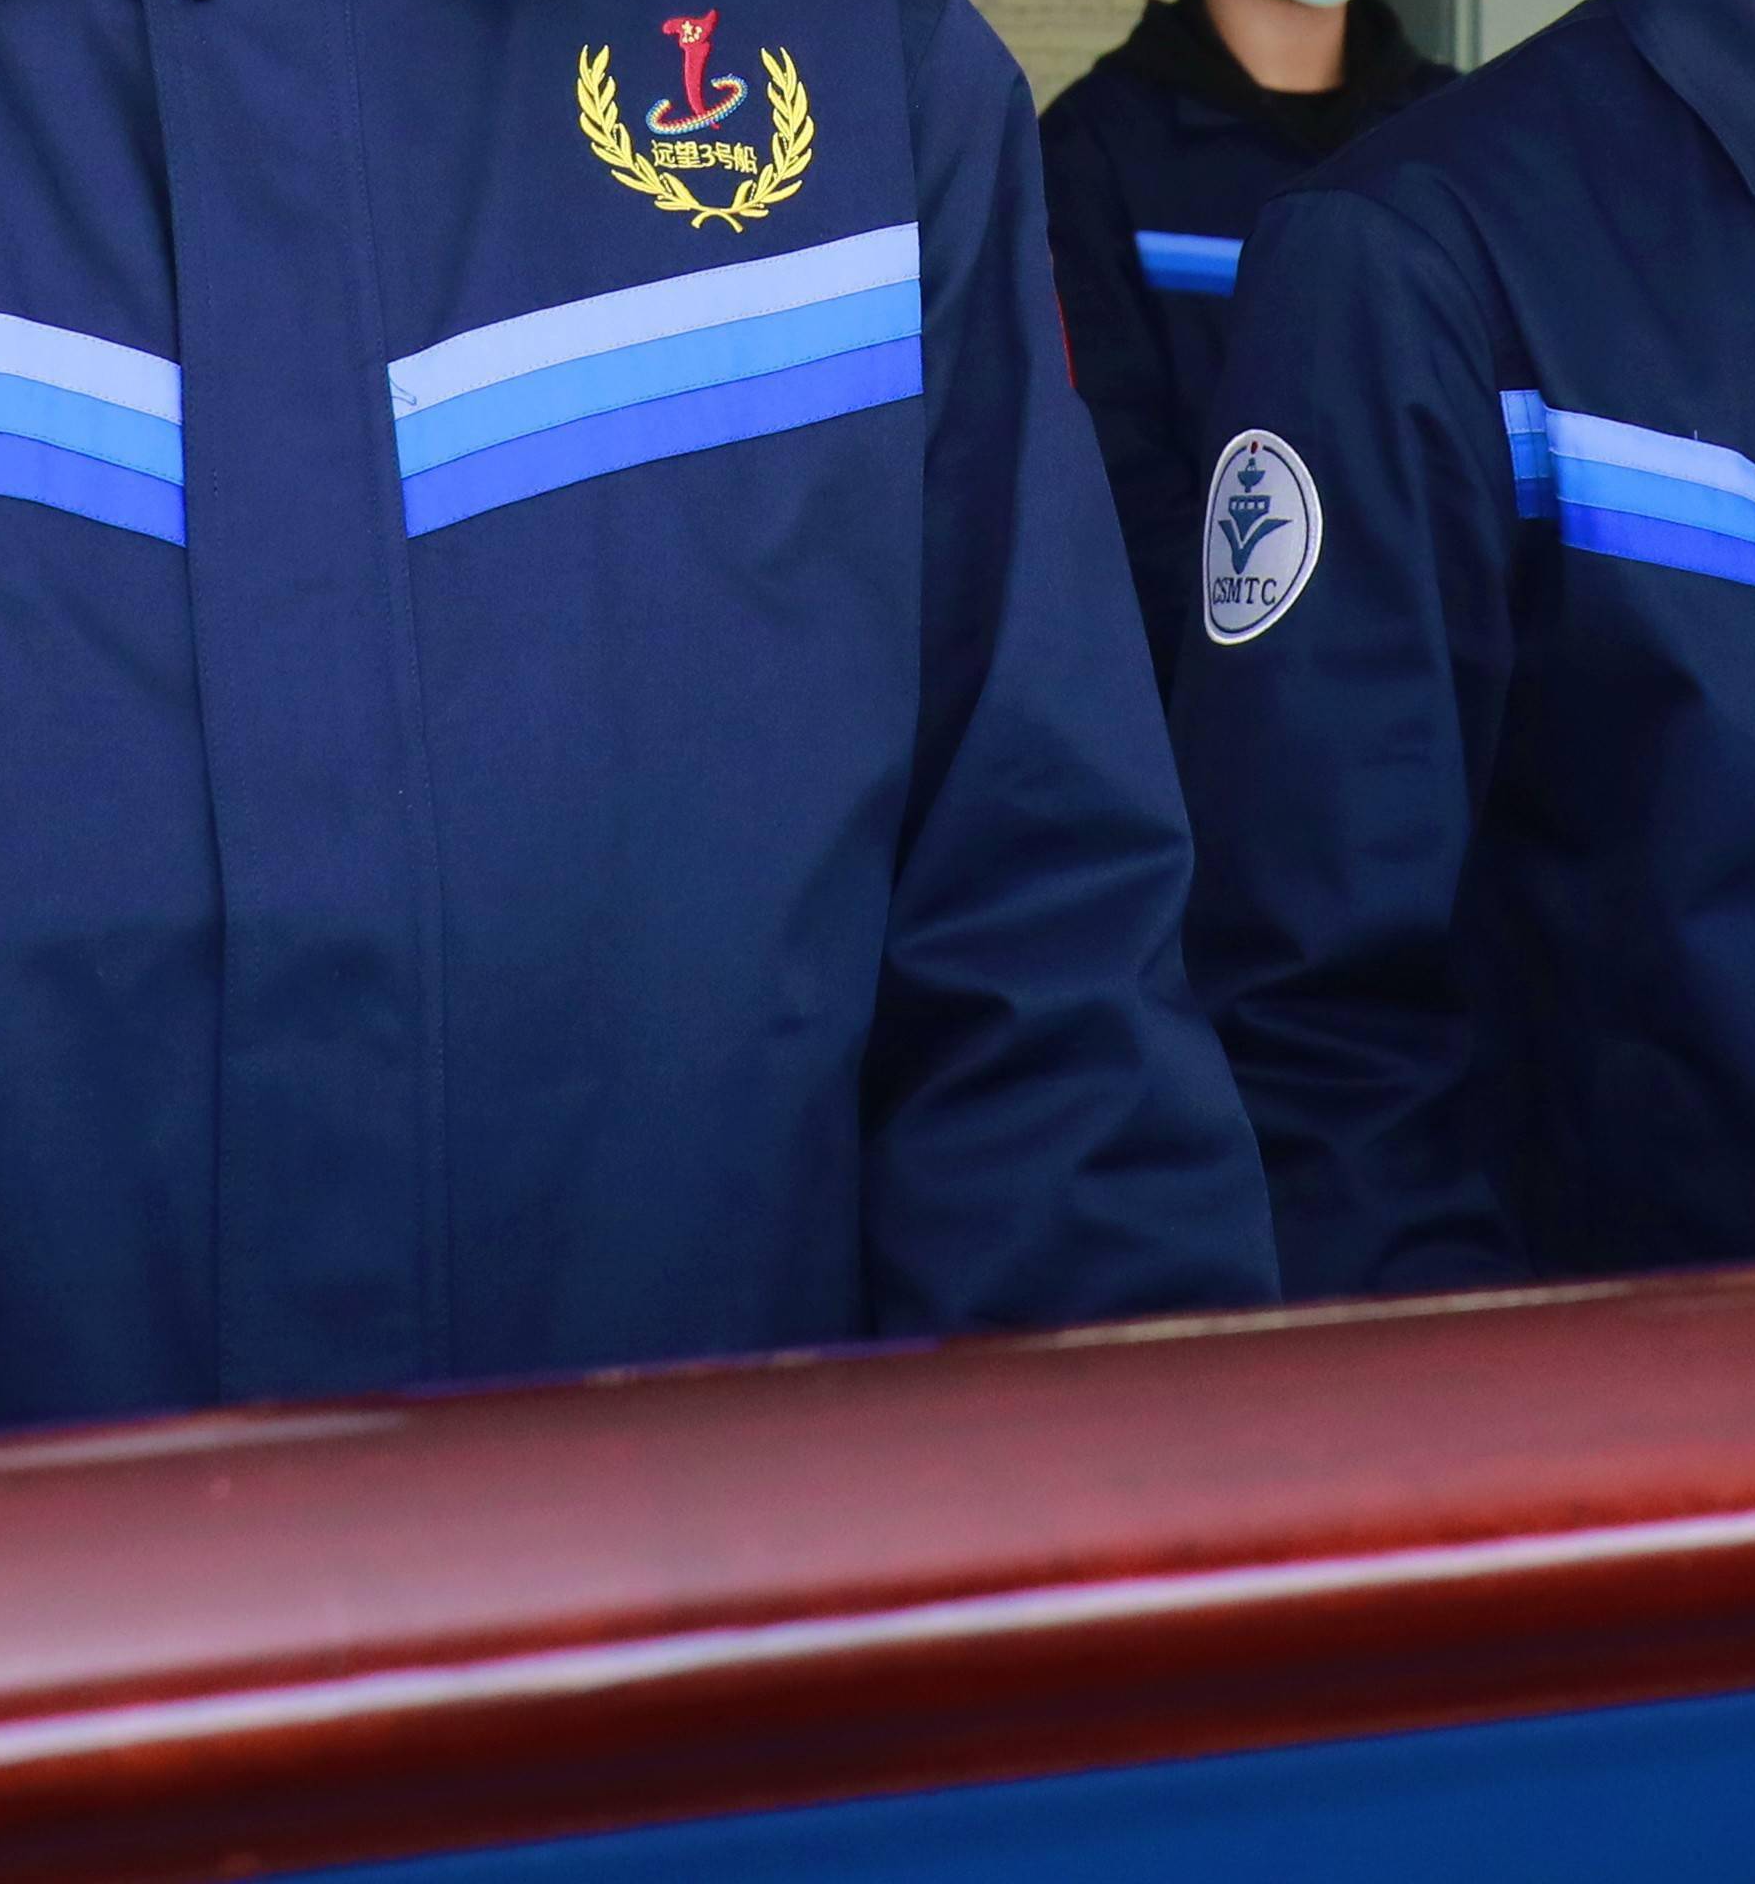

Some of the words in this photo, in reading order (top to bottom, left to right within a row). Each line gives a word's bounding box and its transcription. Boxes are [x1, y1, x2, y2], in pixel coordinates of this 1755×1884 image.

[650, 138, 758, 175] 远望3号船
[1212, 577, 1278, 606] CSMTC
